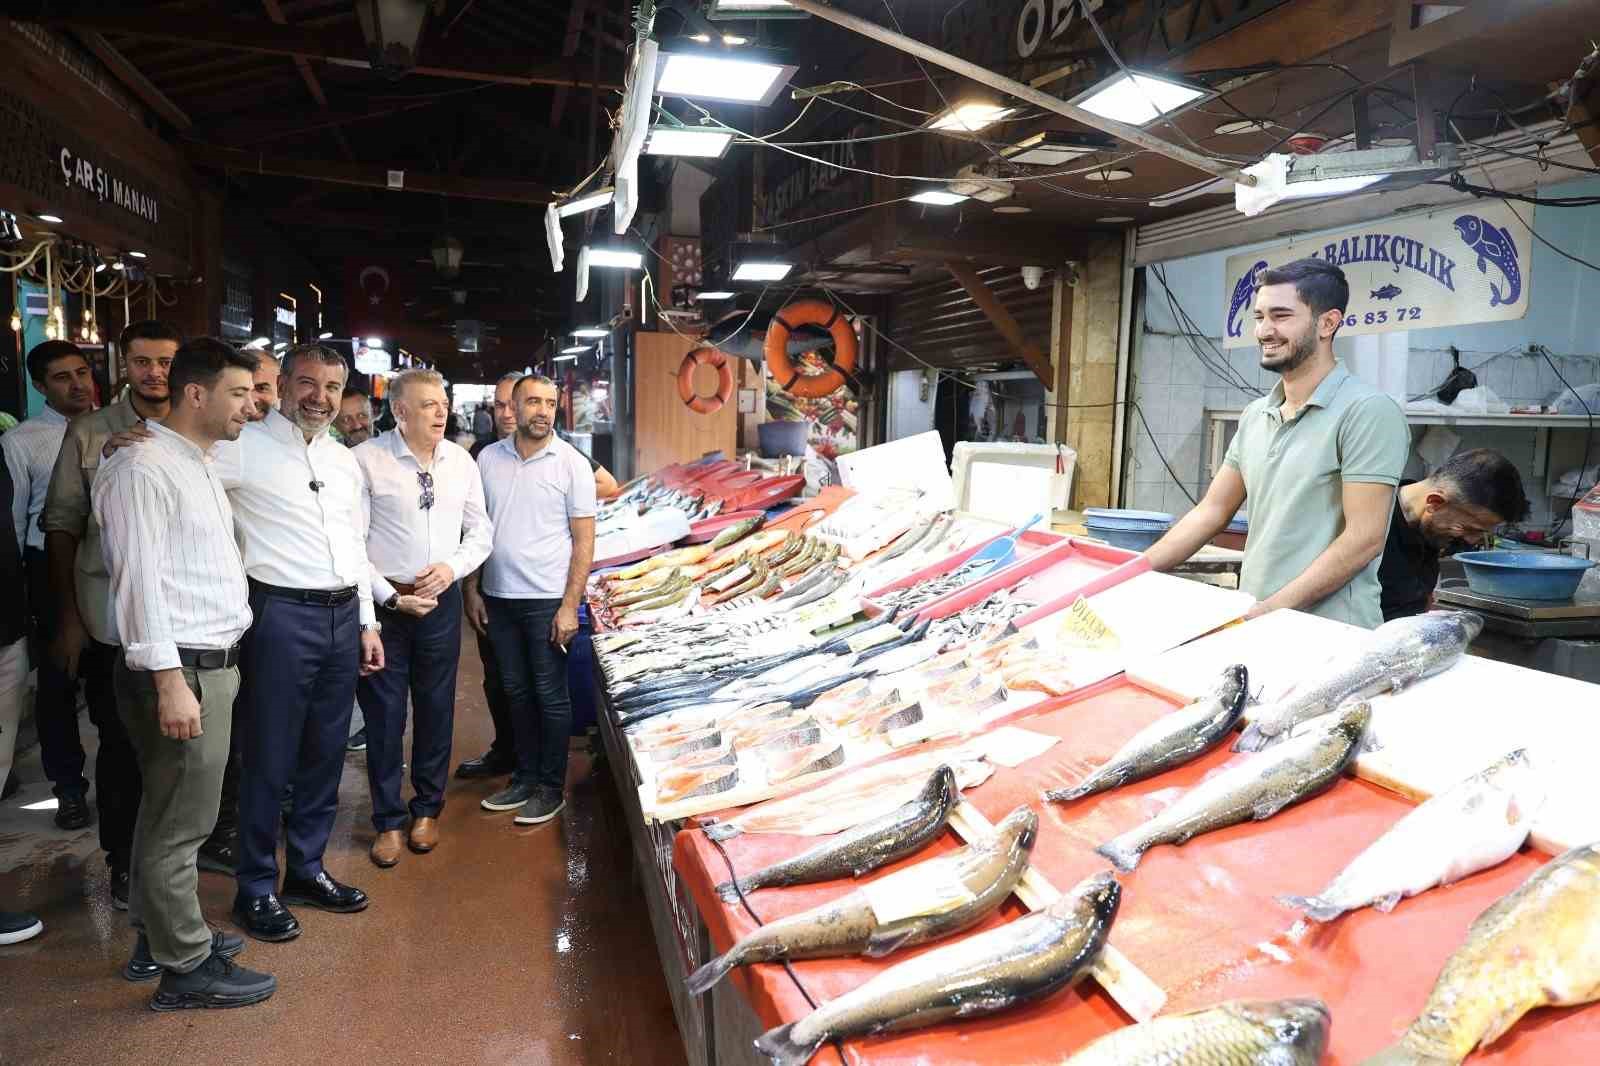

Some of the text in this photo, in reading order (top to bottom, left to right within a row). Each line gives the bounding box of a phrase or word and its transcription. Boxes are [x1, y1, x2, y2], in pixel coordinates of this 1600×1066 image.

[61, 147, 157, 224] ÇARŞI MANAVI
[1324, 234, 1456, 292] BALIKÇILIK
[1364, 310, 1388, 325] 83
[1397, 306, 1422, 321] 72
